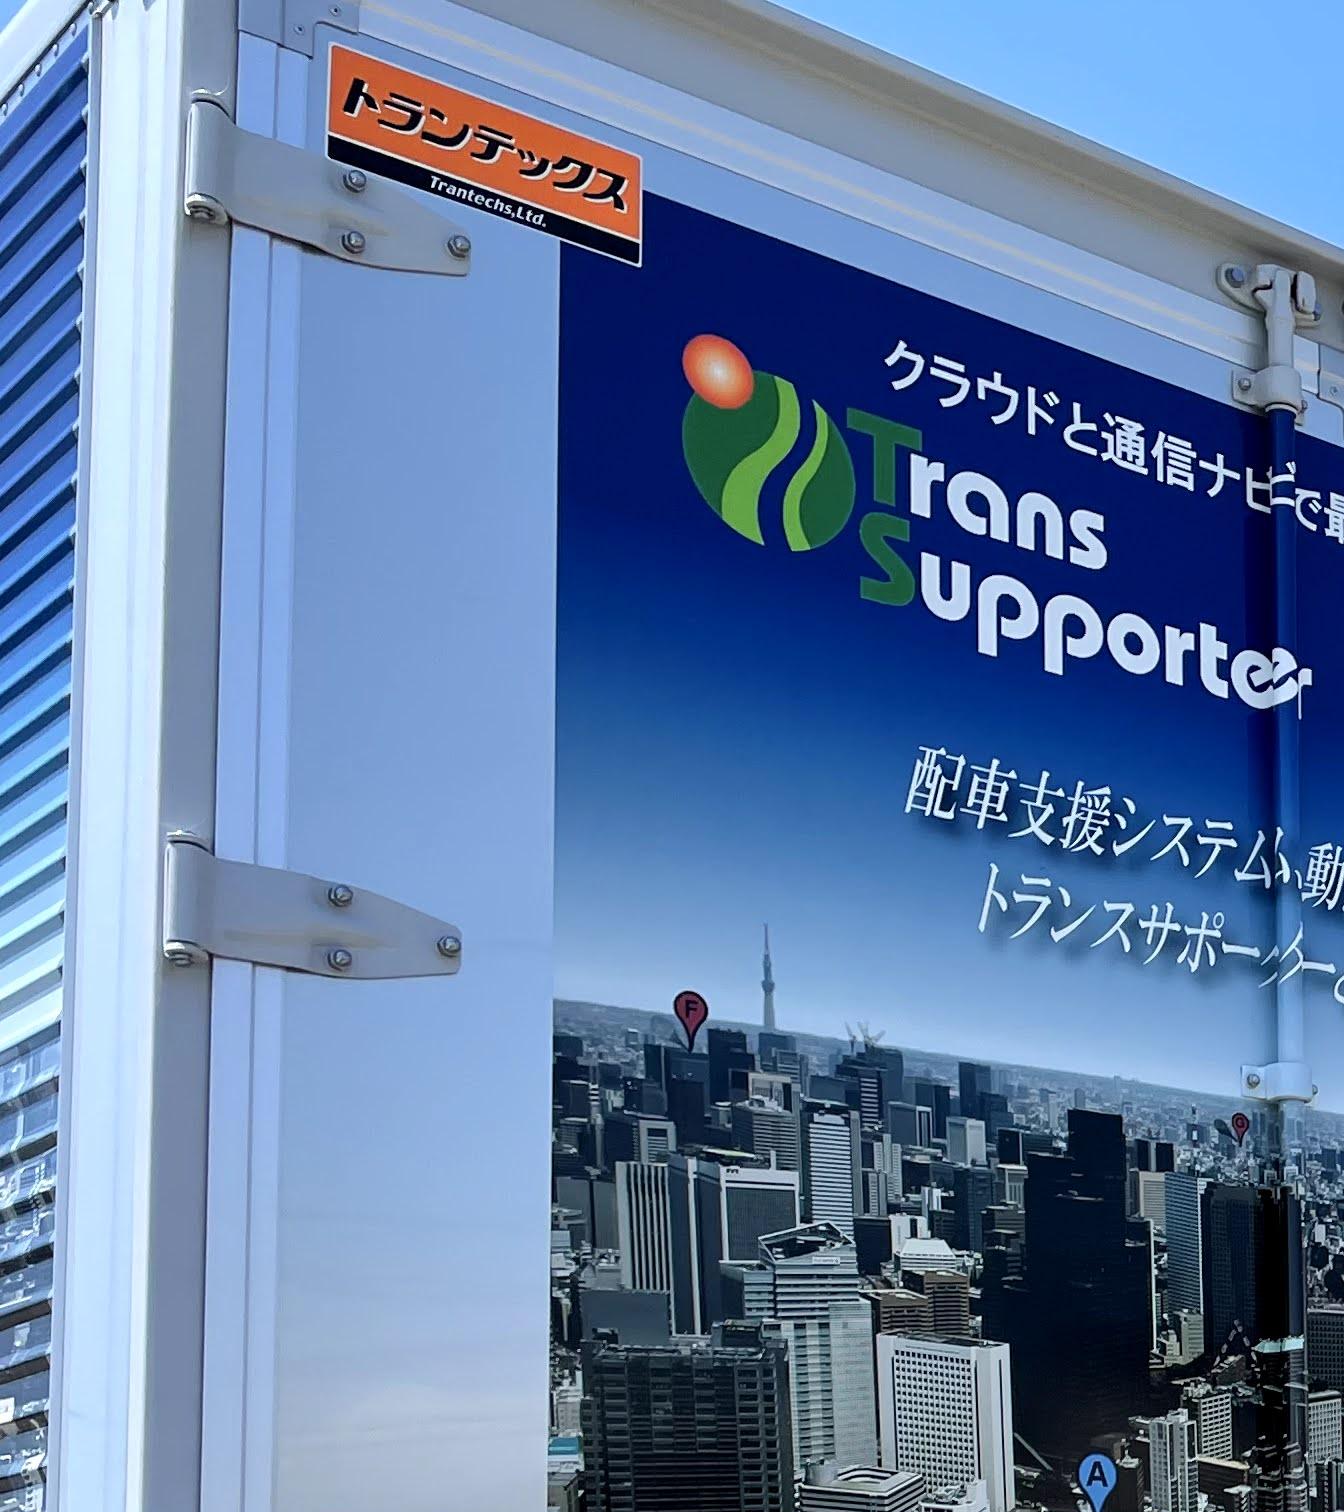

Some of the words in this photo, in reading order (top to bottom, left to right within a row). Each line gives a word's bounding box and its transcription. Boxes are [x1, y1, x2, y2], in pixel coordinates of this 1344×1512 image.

[342, 77, 629, 214] トランテックス
[429, 175, 547, 228] Trantechs,Ltd.
[847, 407, 1107, 570] Trans
[859, 511, 1312, 720] Supporter
[684, 999, 699, 1018] F
[1086, 1460, 1108, 1488] A
